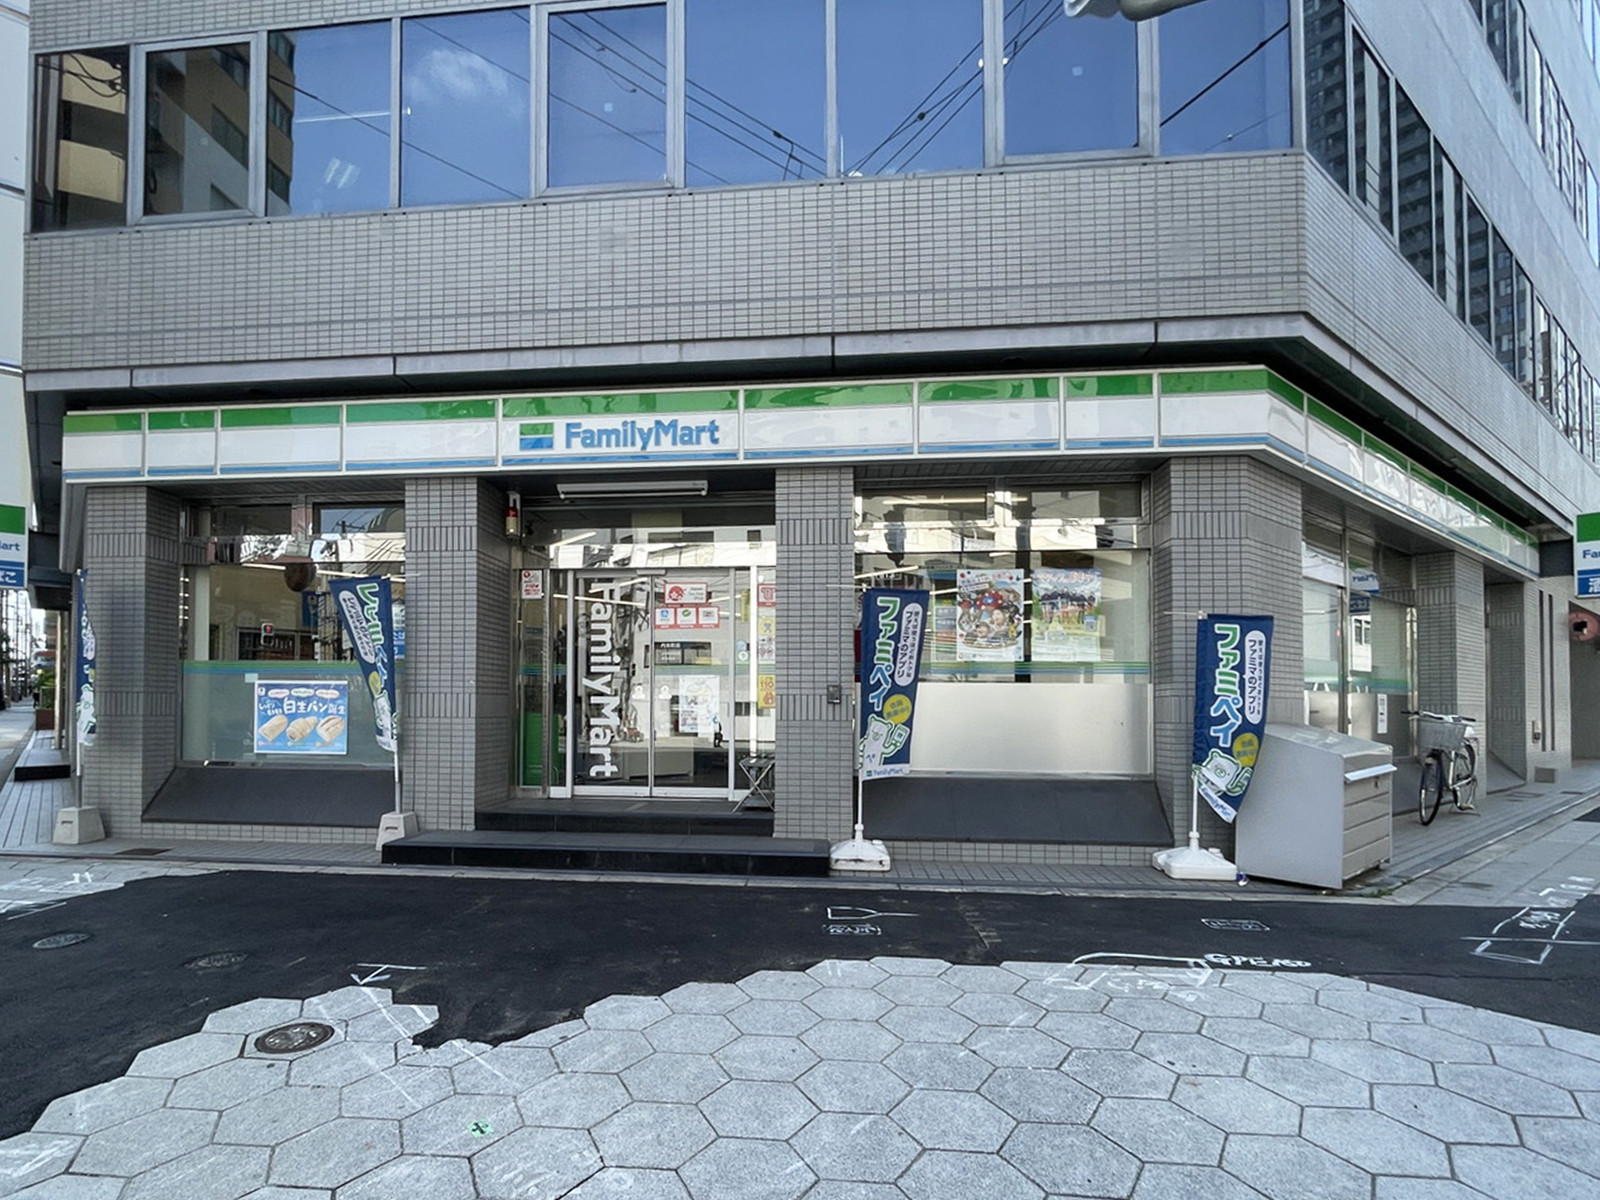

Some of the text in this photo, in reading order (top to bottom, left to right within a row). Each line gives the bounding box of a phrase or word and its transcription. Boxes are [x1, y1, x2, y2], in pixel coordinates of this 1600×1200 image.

[565, 419, 720, 450] FamilyMart
[1583, 549, 1600, 559] Fa
[582, 582, 621, 777] FamilyMart
[870, 597, 900, 711] ファミペイ
[897, 611, 913, 678] ファミマのアプリ
[1247, 639, 1258, 715] ファミマのアプリ
[1210, 624, 1243, 747] ファミペイ
